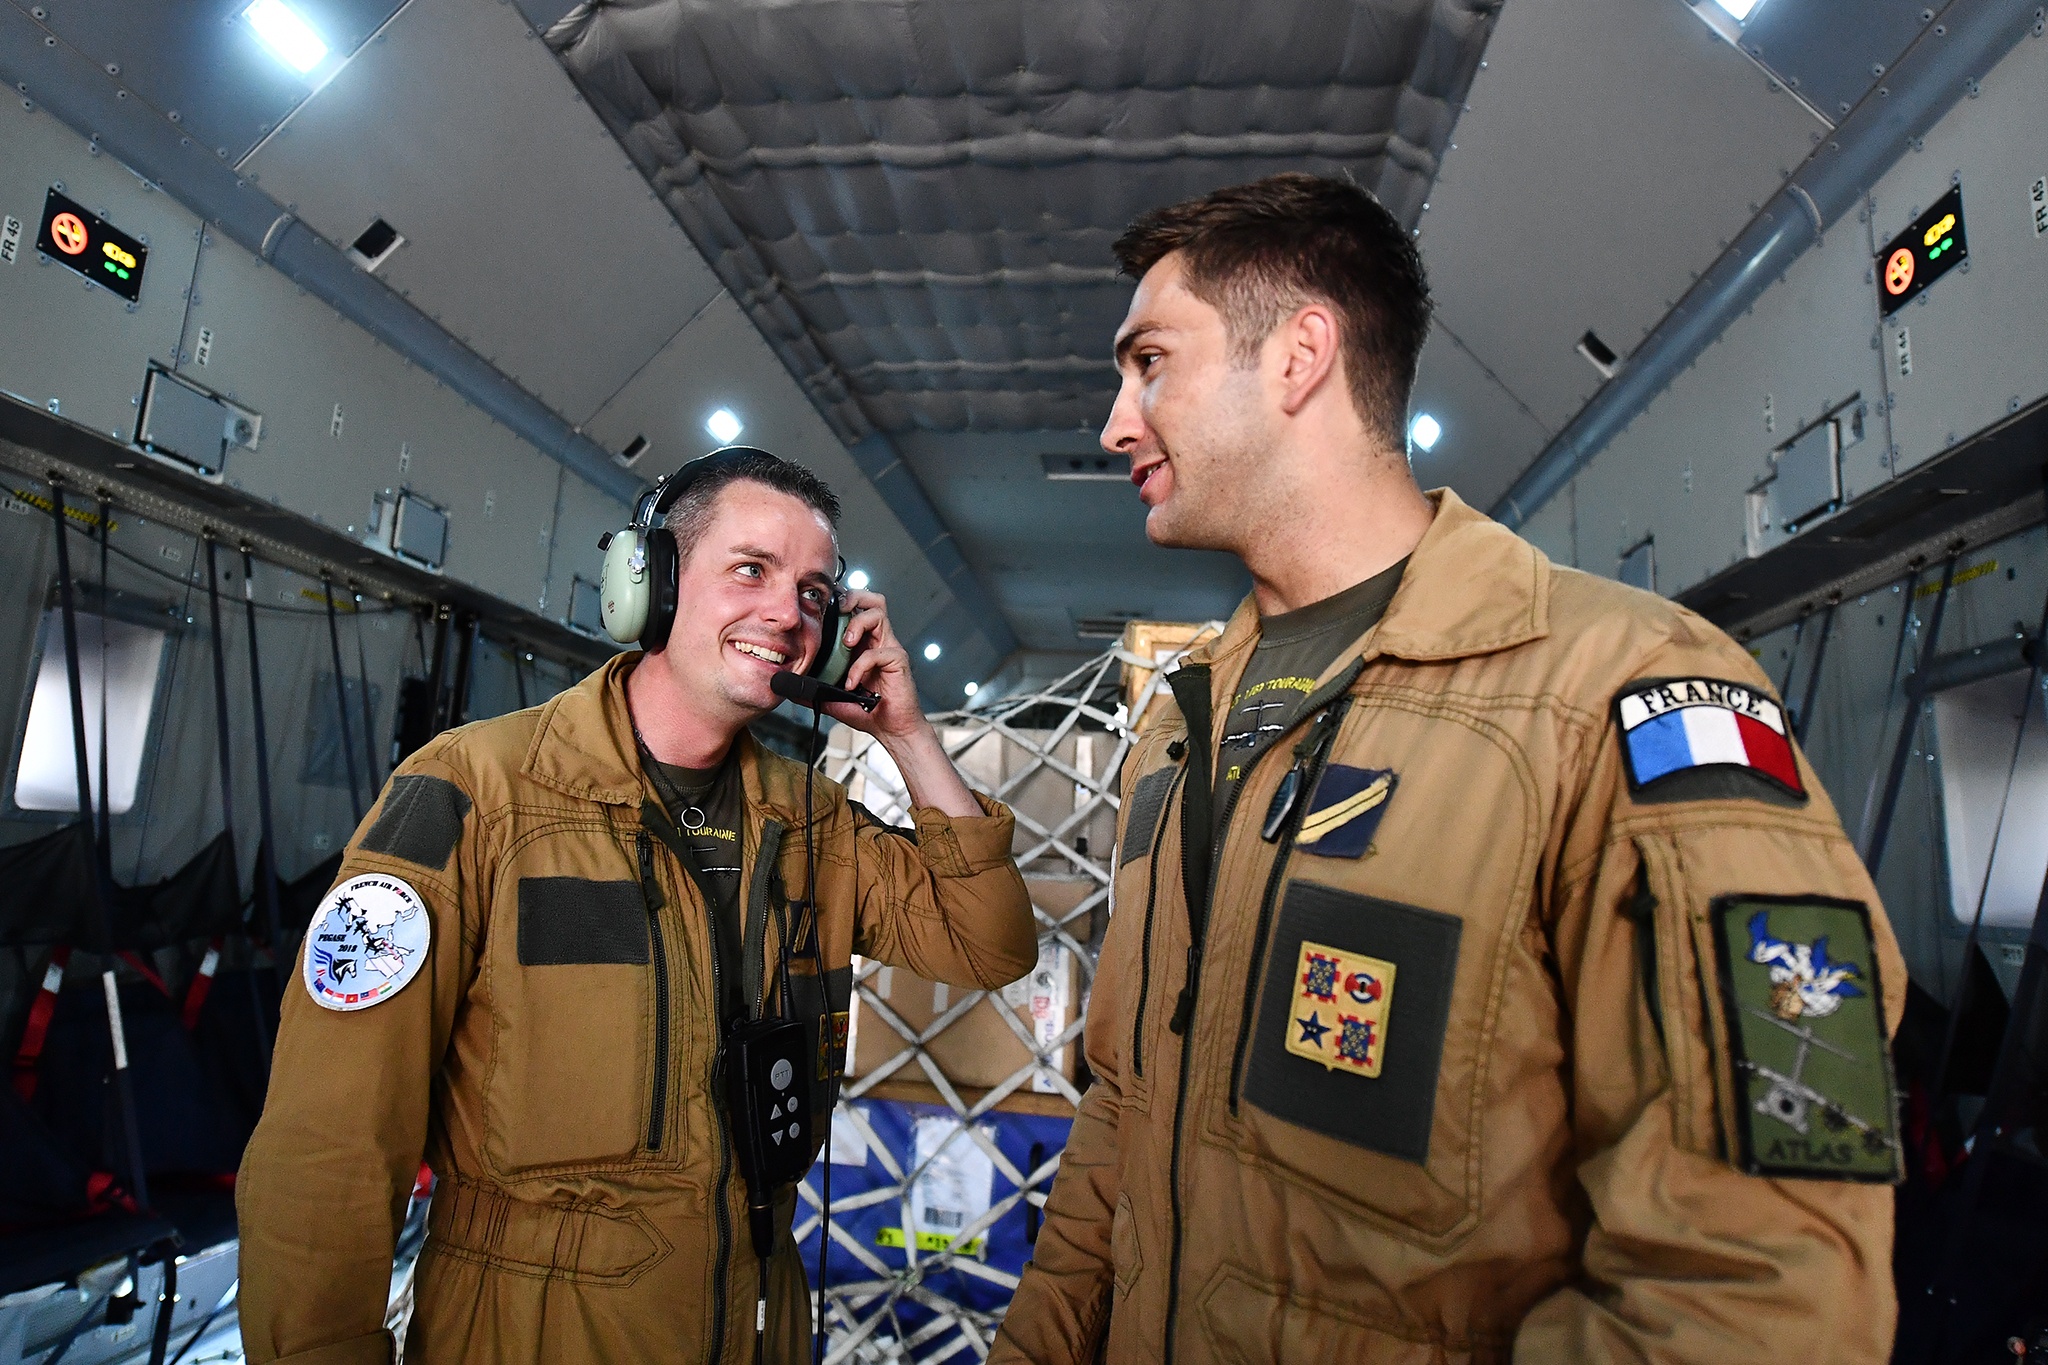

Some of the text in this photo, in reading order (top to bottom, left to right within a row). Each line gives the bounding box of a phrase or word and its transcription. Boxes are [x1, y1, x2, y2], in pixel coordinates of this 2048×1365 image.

[2032, 180, 2048, 233] FR 45
[1, 219, 20, 261] FR 45
[1639, 682, 1765, 716] FRANCE
[1226, 765, 1241, 781] ATL
[686, 826, 736, 841] TOURAINE
[351, 880, 412, 903] FRENCH AIR FORCE
[317, 933, 347, 942] PEGASE
[338, 944, 358, 953] 2018
[1768, 1138, 1852, 1164] ATLAS
